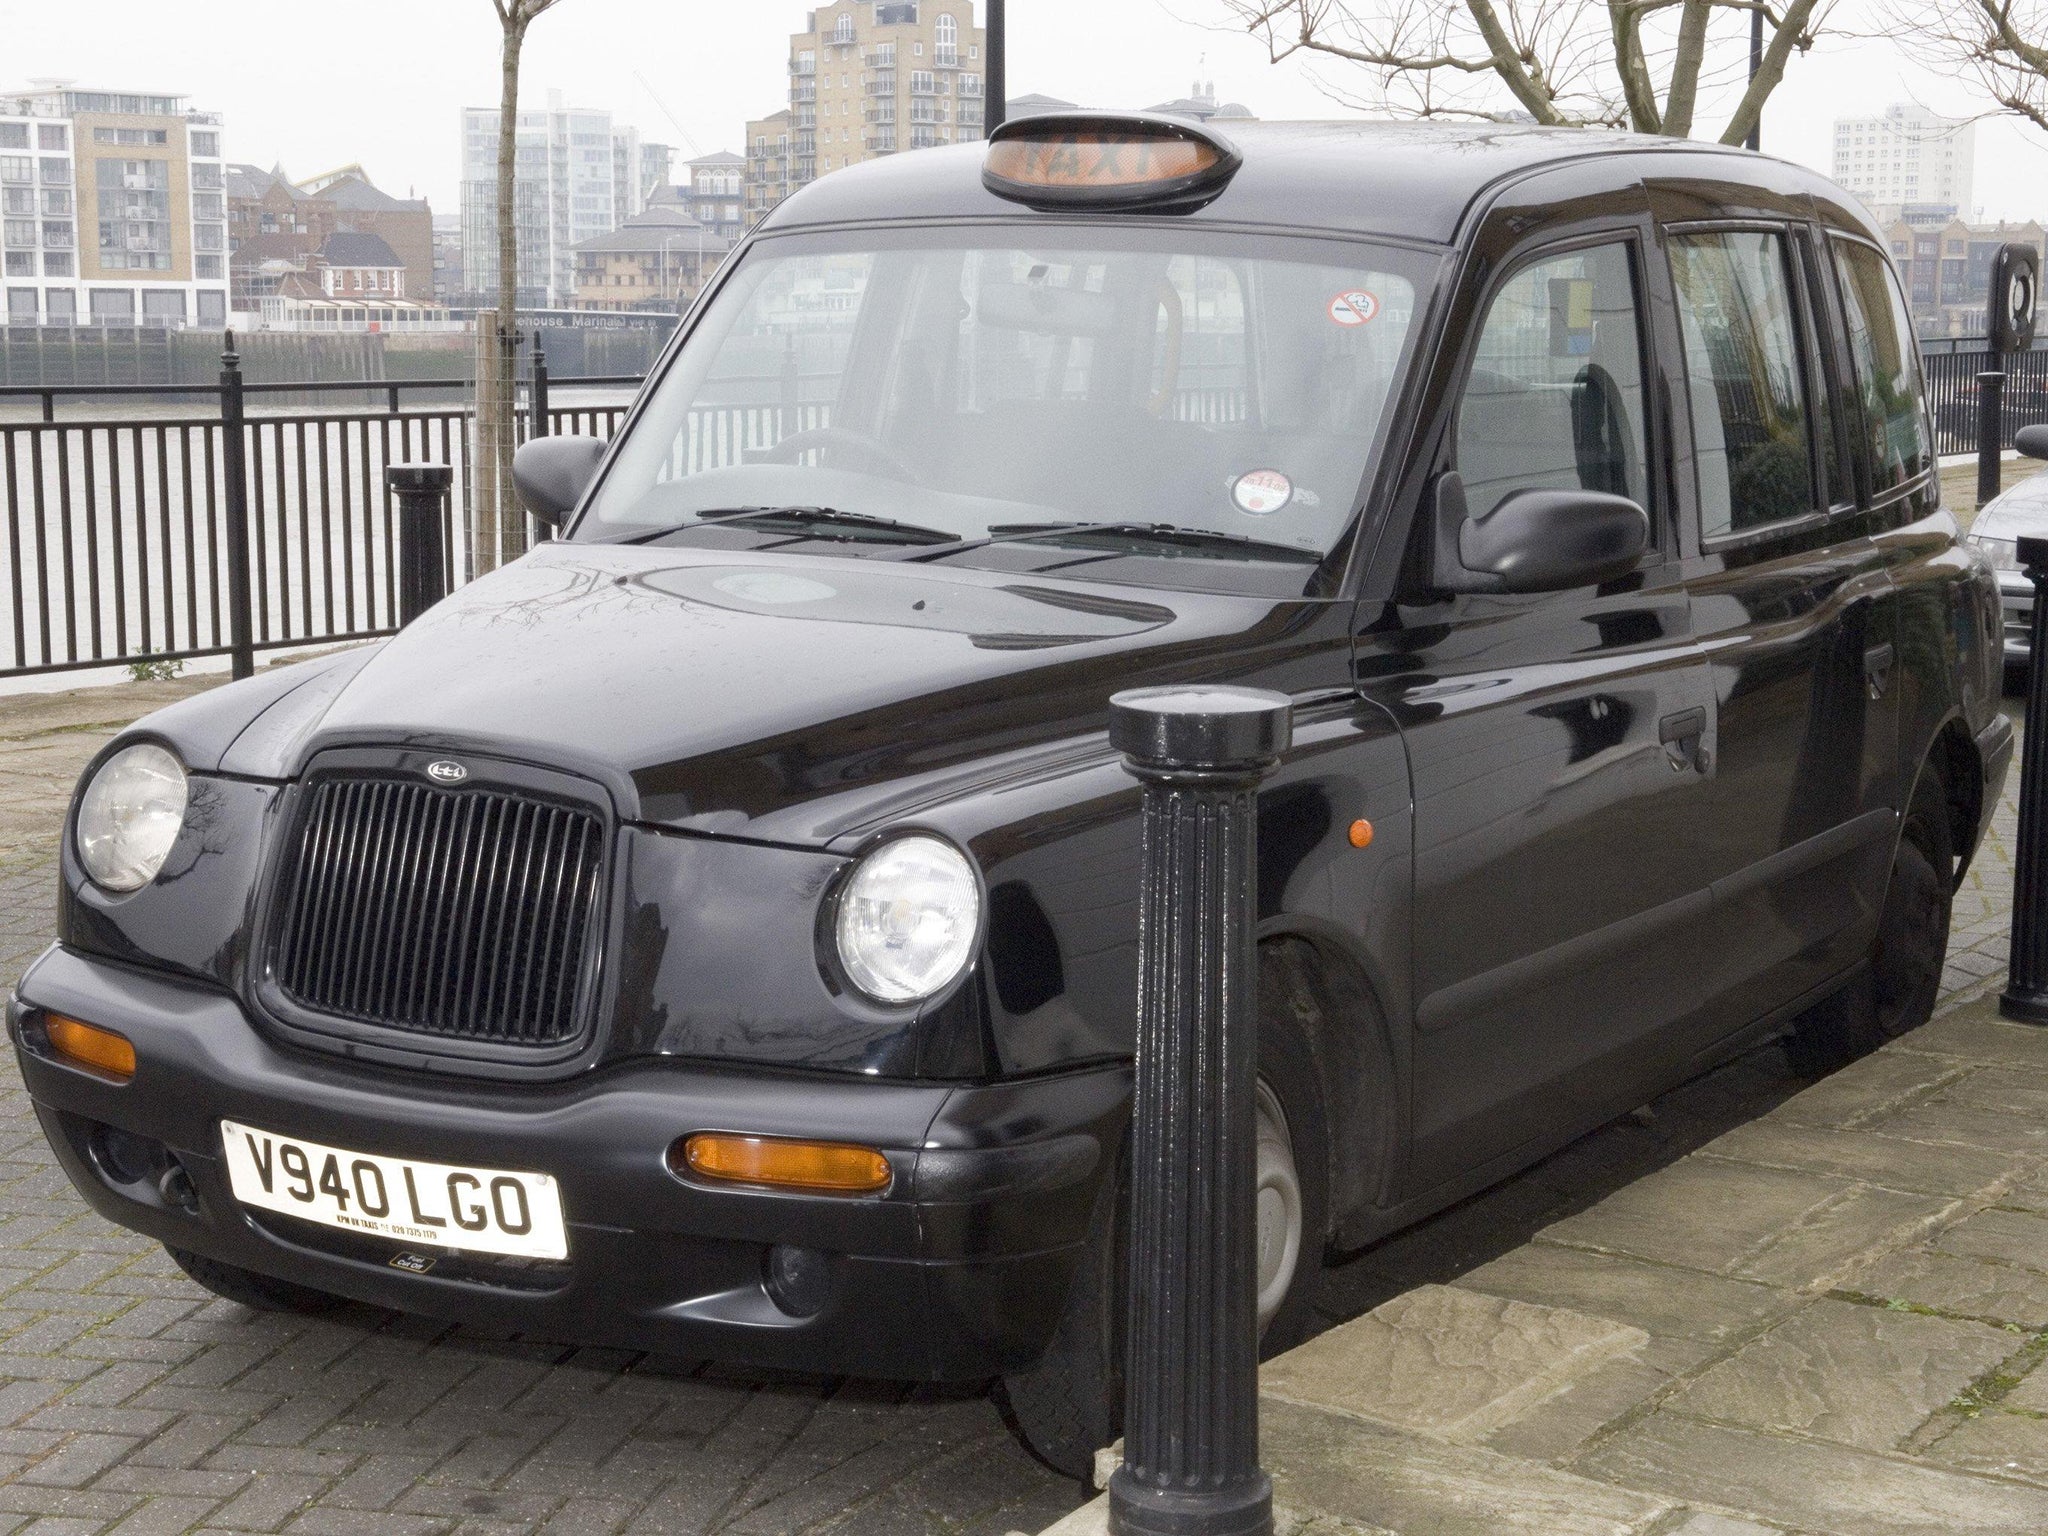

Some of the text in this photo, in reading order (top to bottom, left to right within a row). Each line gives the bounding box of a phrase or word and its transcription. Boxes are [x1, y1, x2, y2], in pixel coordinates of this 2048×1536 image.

[1022, 134, 1154, 178] TAXI
[572, 314, 614, 327] Marina
[245, 1133, 532, 1236] V940 LGO
[360, 1219, 379, 1231] TAXIS
